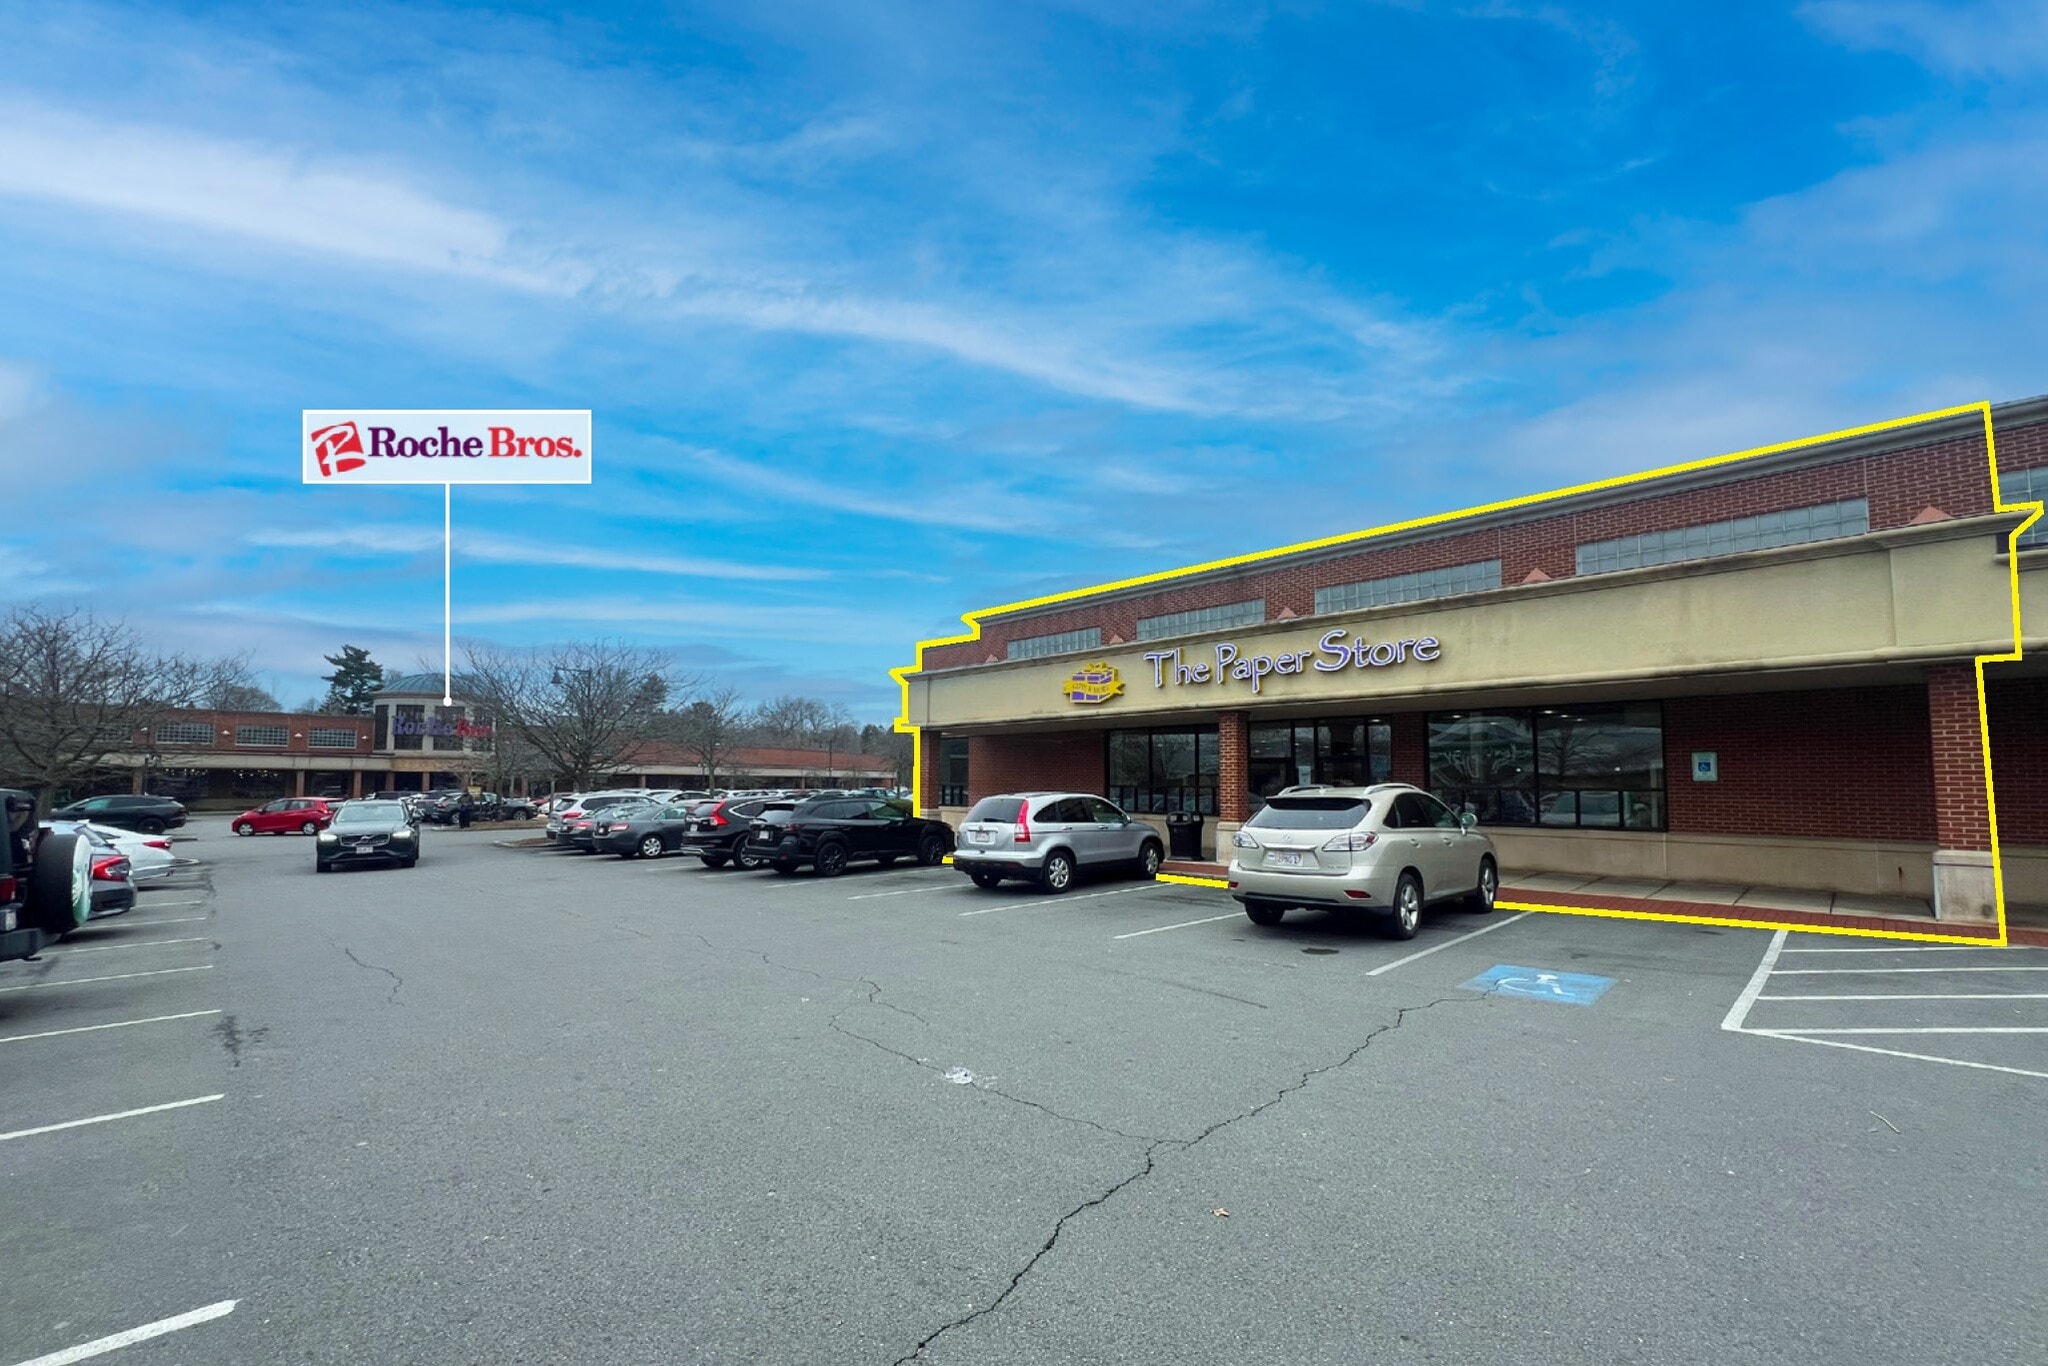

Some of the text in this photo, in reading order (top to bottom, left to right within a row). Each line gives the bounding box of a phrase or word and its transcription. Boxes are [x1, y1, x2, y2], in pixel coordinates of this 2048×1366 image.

[1144, 629, 1440, 694] The Paper Store
